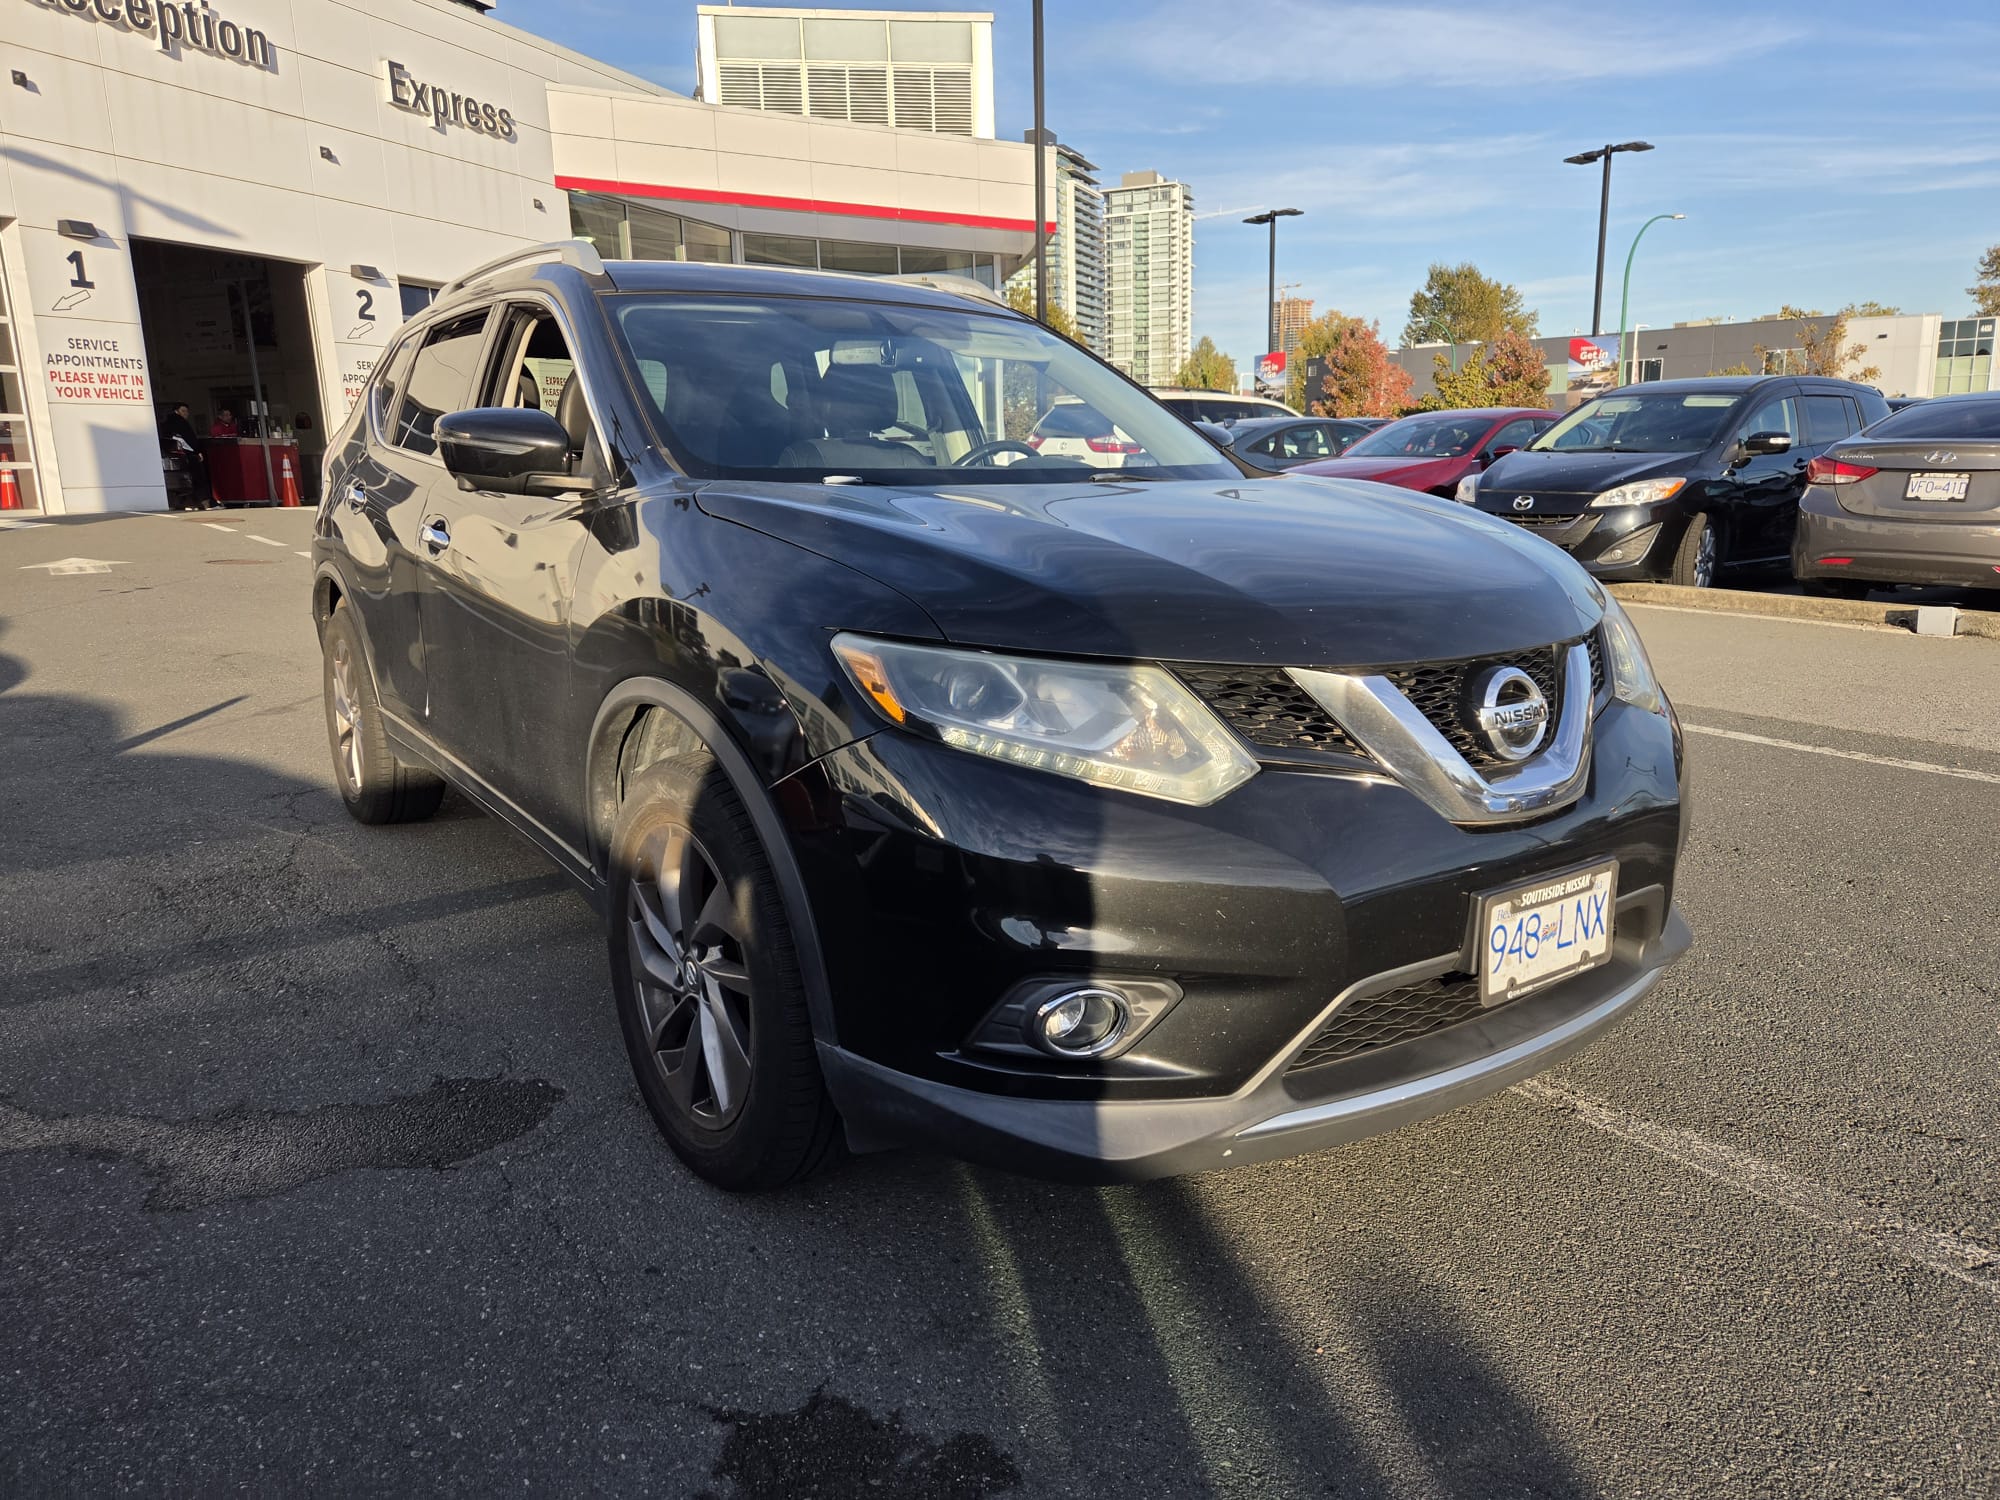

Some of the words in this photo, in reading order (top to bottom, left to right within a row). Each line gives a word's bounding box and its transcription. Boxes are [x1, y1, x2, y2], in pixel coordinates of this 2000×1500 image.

[46, 0, 270, 65] ception
[386, 60, 513, 137] Express
[66, 250, 95, 290] 1
[356, 289, 376, 321] 2
[68, 337, 119, 352] SERVICE
[47, 353, 143, 370] APPOINTMENTS
[50, 370, 95, 384] PLEASE
[97, 373, 129, 385] WAIT
[131, 375, 144, 386] IN
[56, 386, 92, 398] YOUR
[94, 388, 145, 400] VEHICLE
[1494, 703, 1547, 725] NISSAN
[1520, 882, 1566, 907] SOUTHSIDE
[1565, 873, 1592, 894] NISSAN
